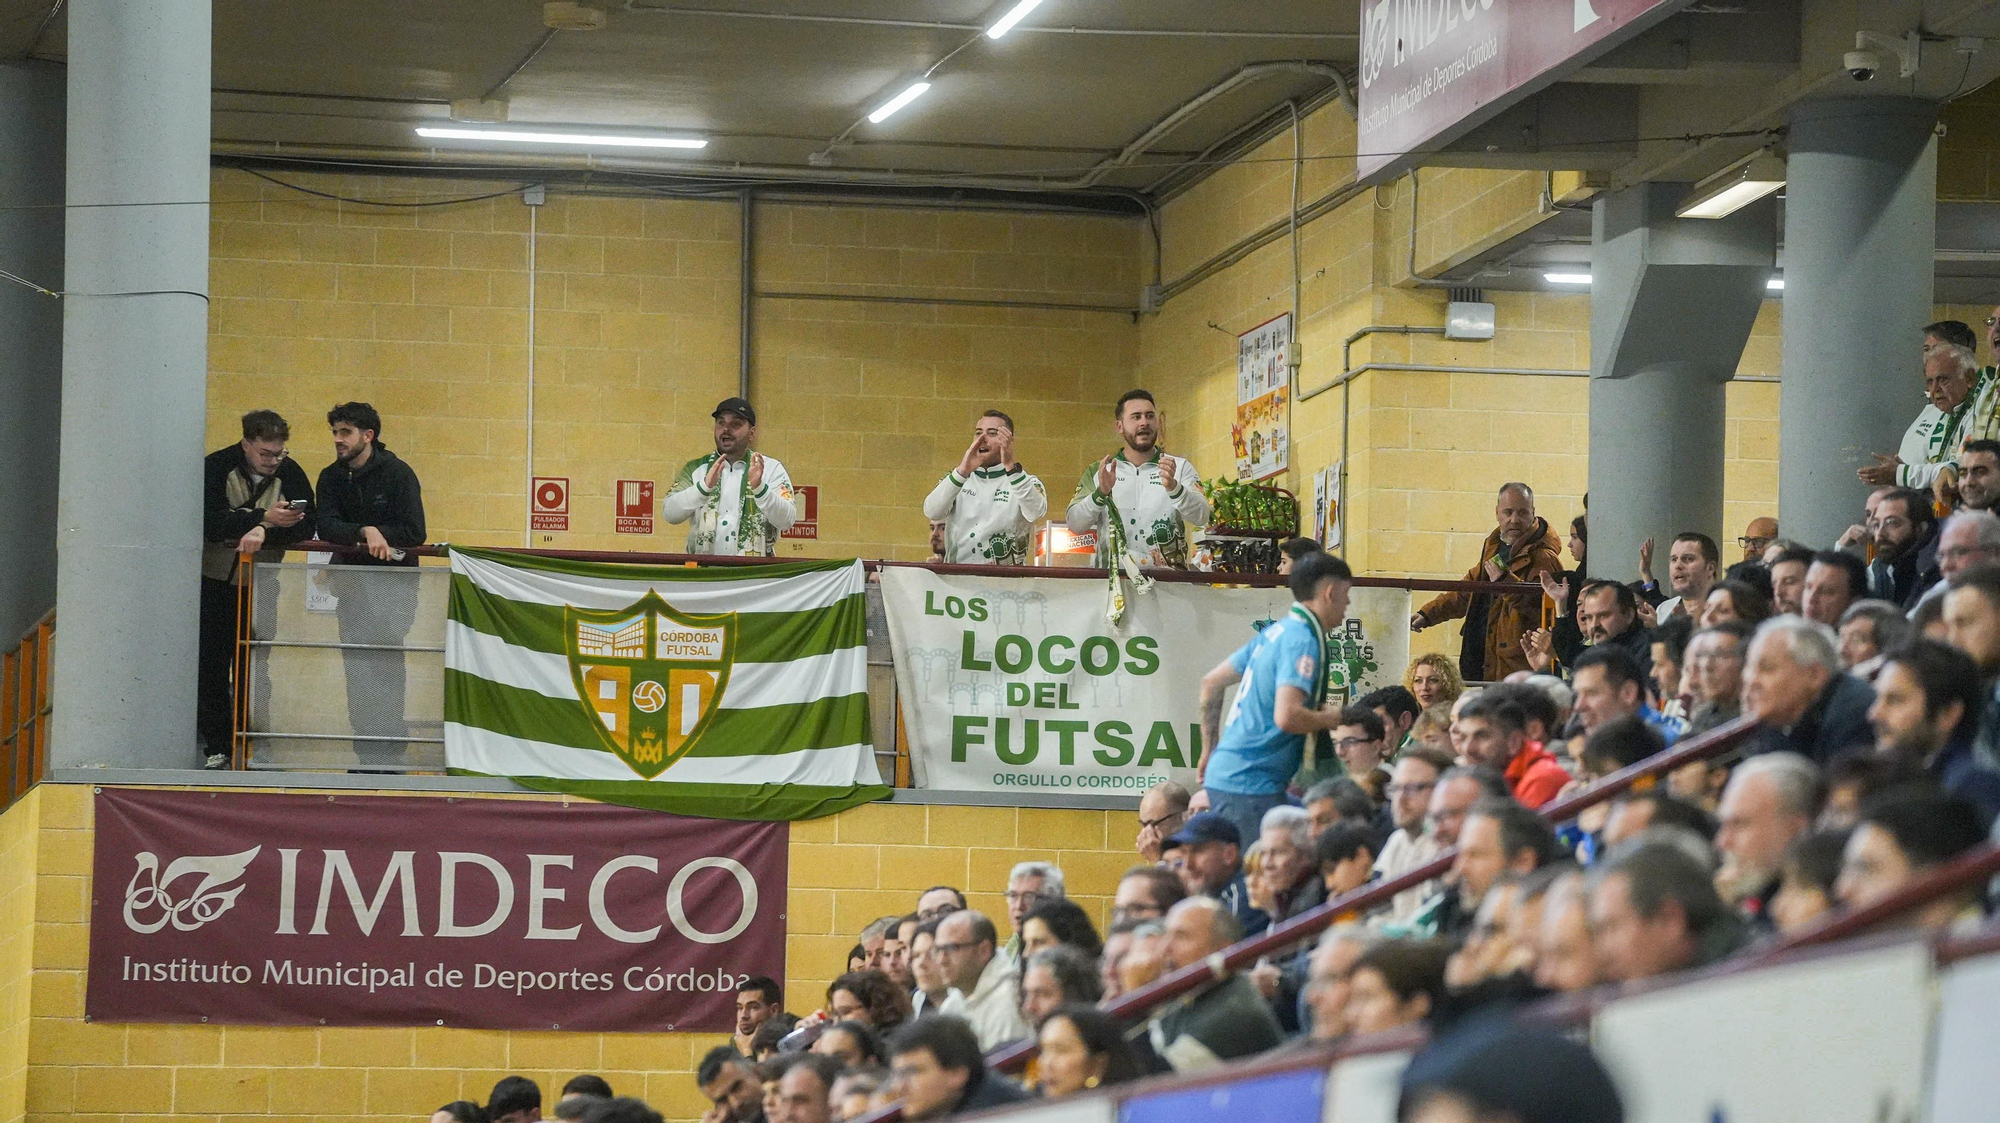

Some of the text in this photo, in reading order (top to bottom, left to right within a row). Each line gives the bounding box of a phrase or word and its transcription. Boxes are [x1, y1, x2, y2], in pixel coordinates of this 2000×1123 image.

[1361, 31, 1498, 137] Instituto Municipal de Deportes Córdoba
[618, 518, 638, 526] BOCA
[1070, 534, 1093, 543] EXICAN
[925, 591, 988, 621] LOS
[660, 630, 719, 643] CÓRDOBA
[667, 645, 712, 656] FUTSAL
[961, 630, 1160, 676] LOCOS
[1007, 682, 1080, 709] DEL
[992, 773, 1072, 788] ORGULLO
[274, 848, 760, 944] IMDECO
[121, 955, 752, 997] Instituto Municipal de Deportes Córdoba
